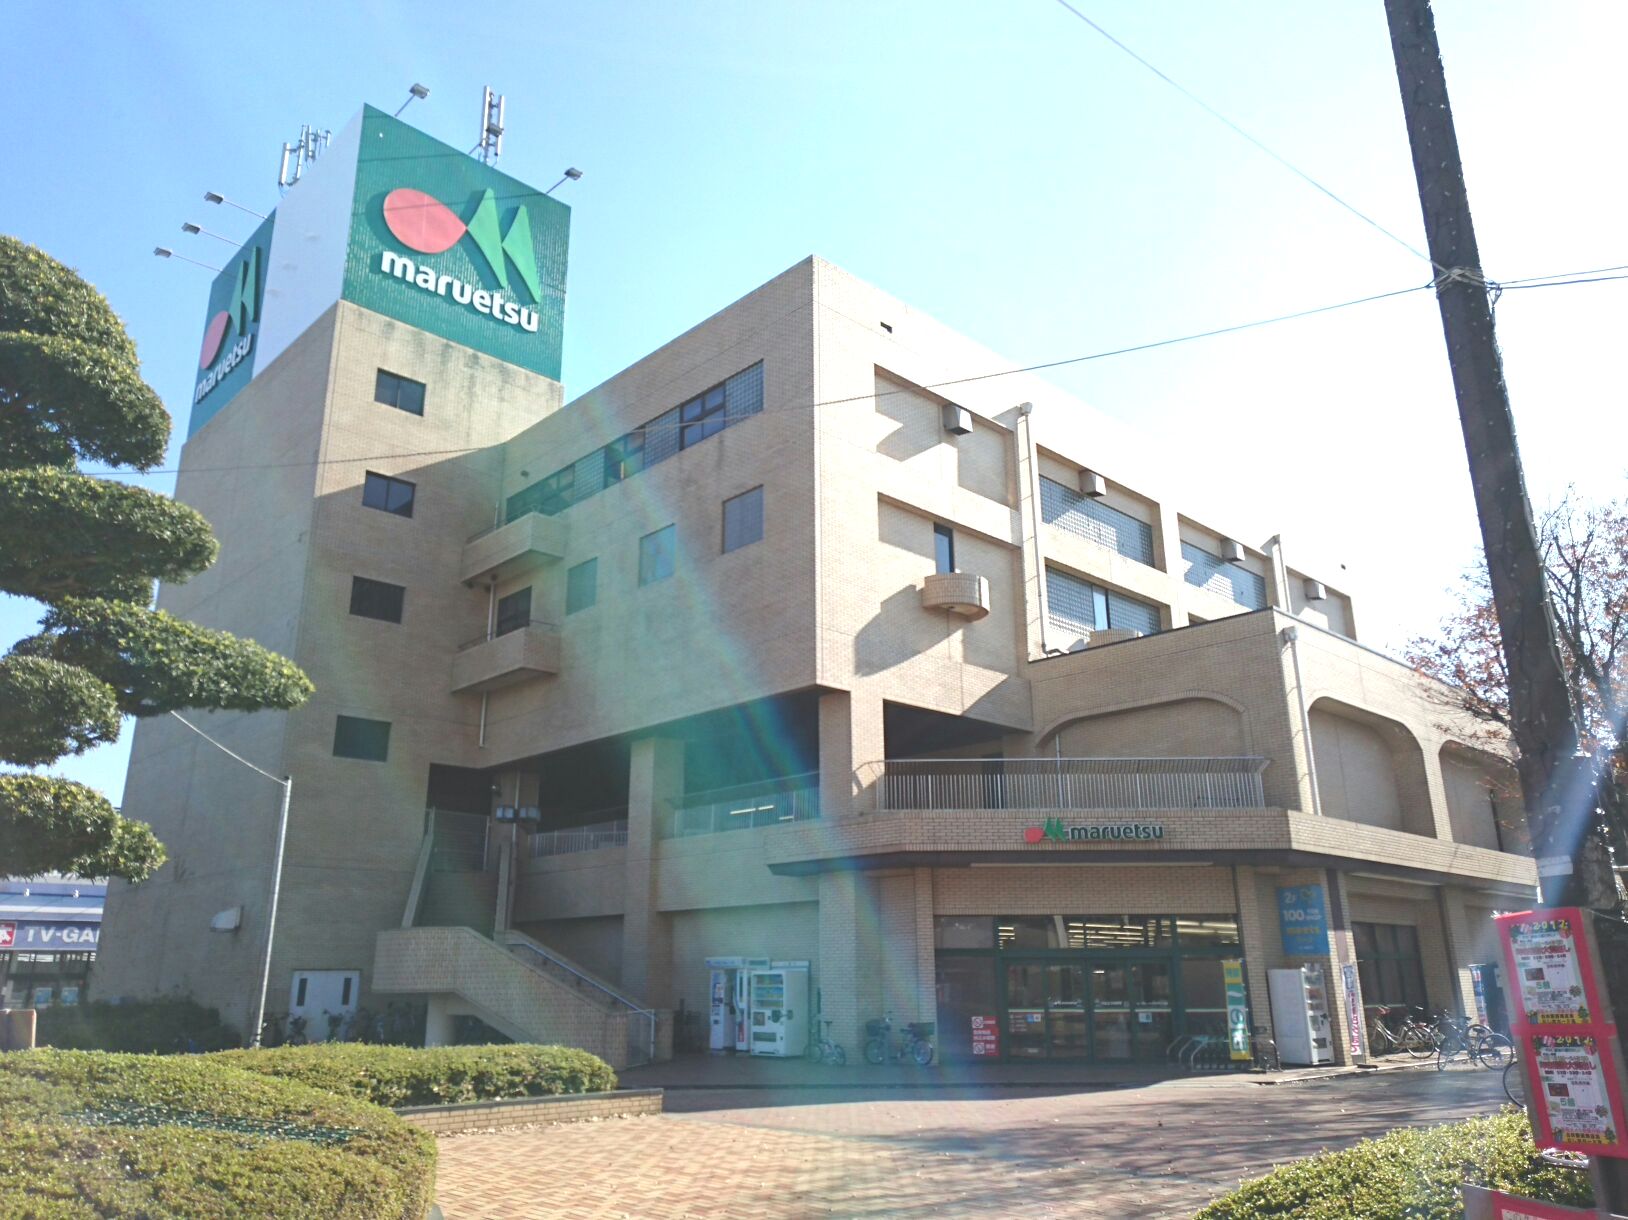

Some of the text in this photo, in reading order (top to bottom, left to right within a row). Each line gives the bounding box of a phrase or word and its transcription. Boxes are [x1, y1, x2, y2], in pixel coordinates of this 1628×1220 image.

[381, 251, 539, 332] maruetsu
[195, 333, 252, 403] maruetsu
[1069, 823, 1164, 840] maruetsu
